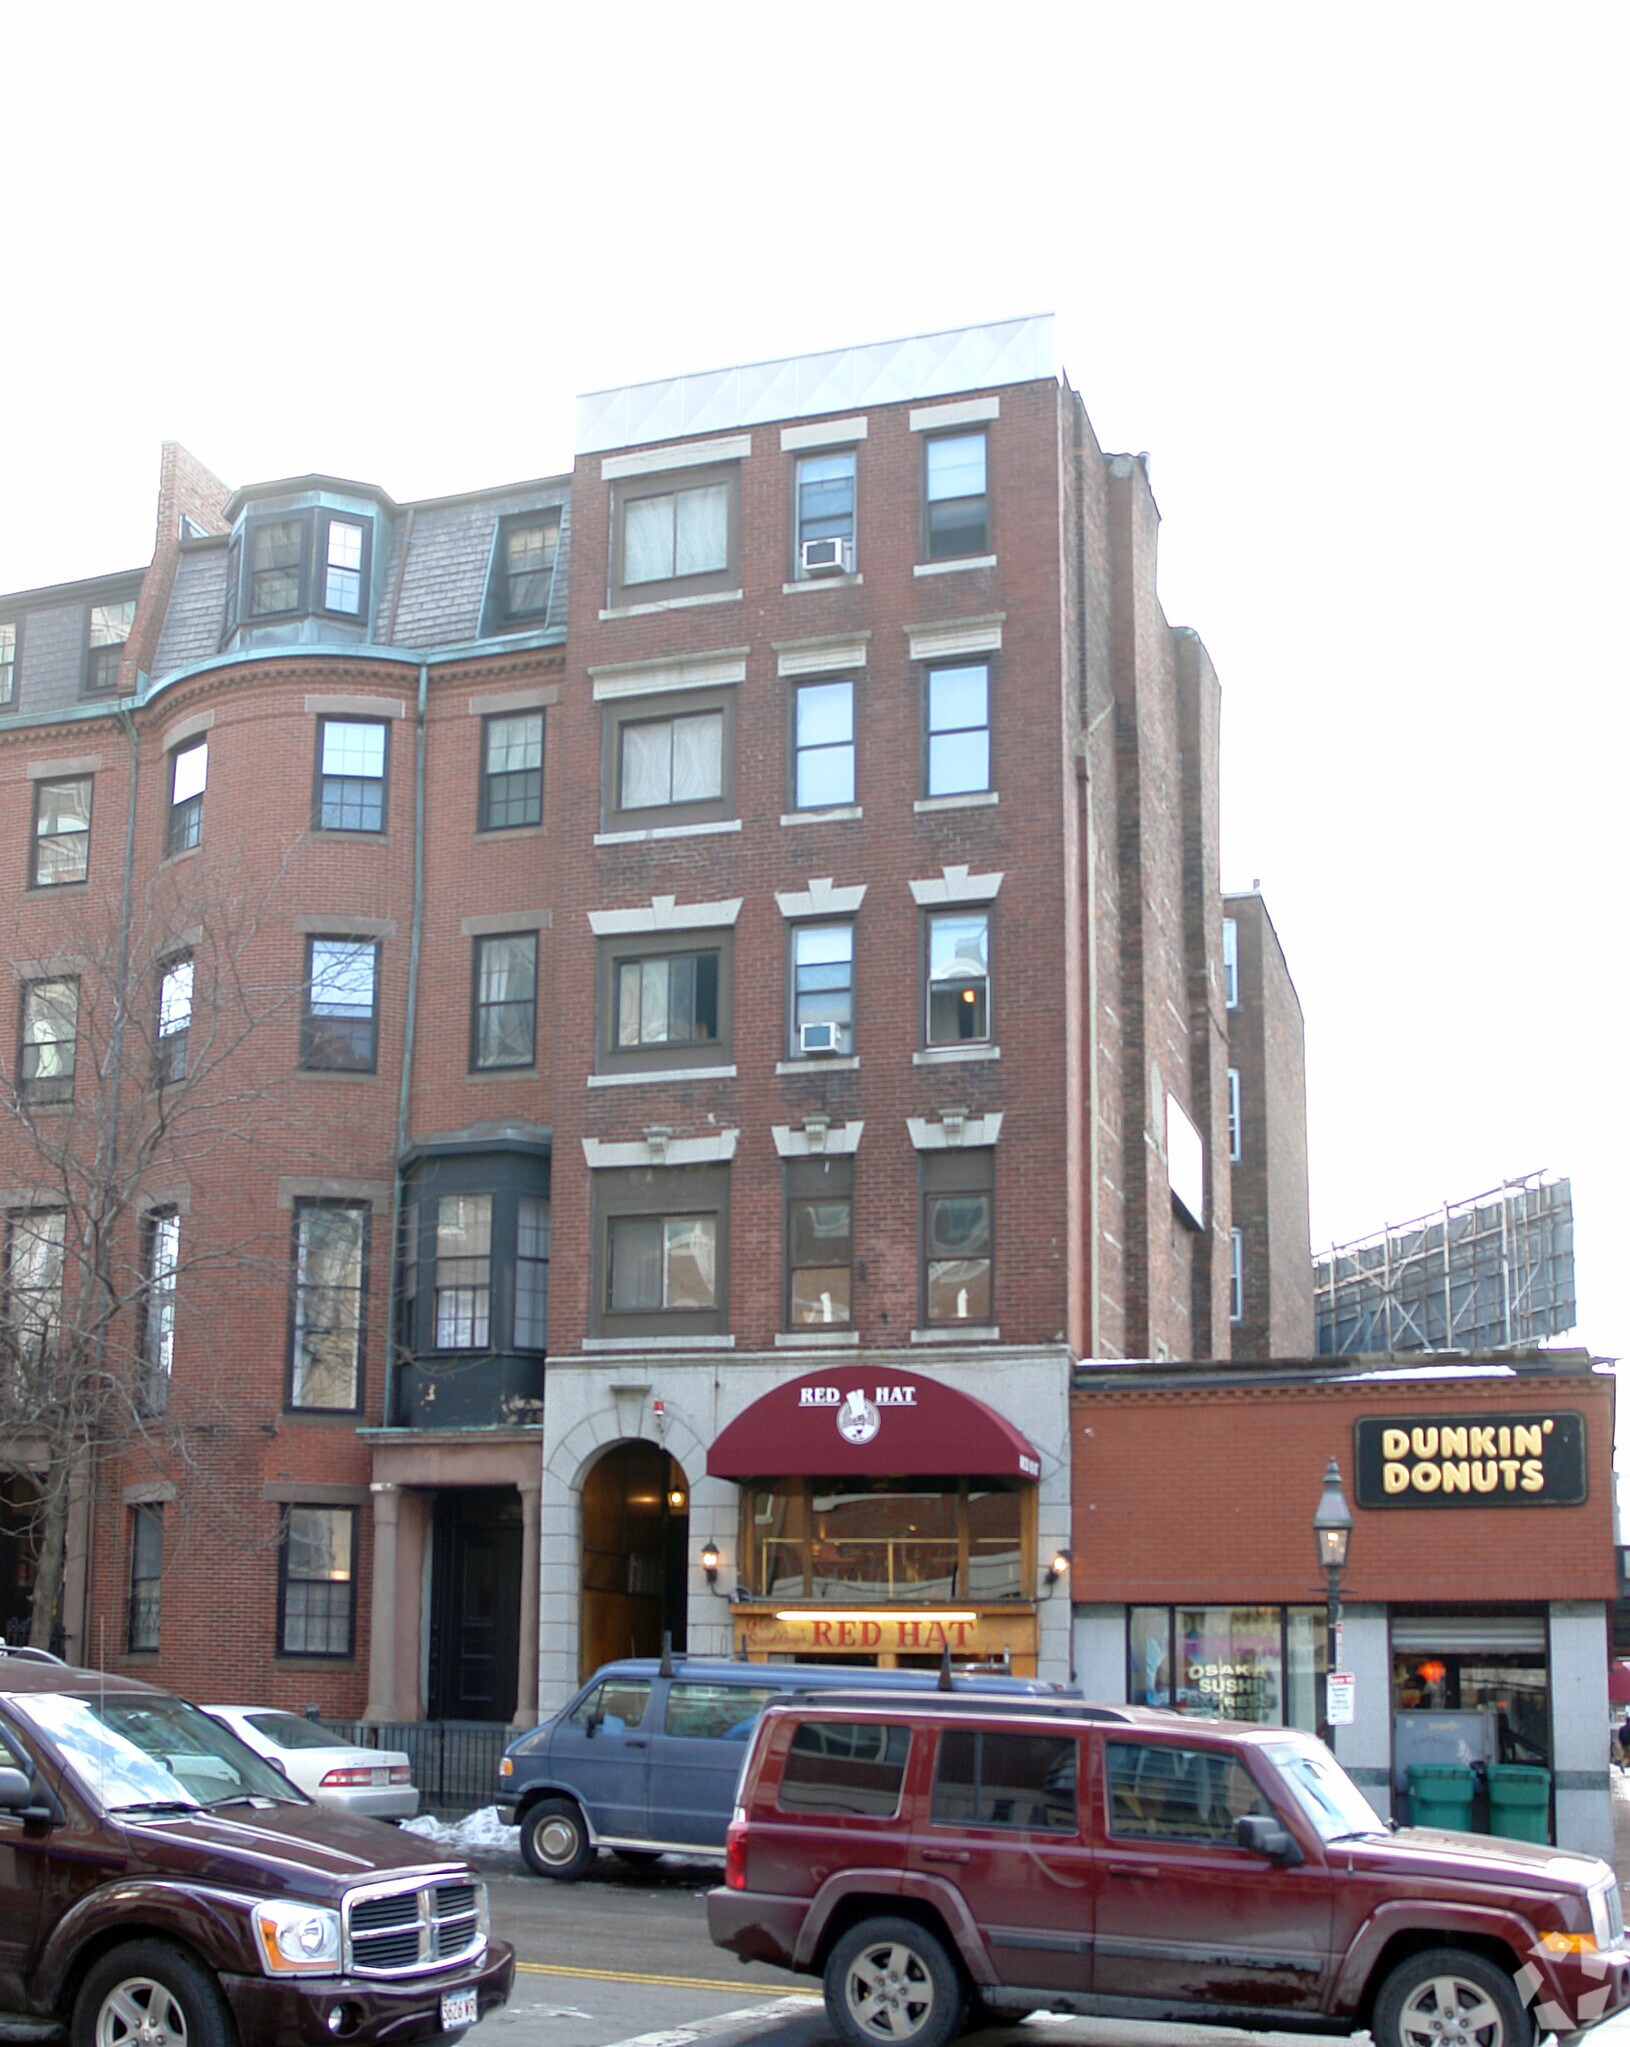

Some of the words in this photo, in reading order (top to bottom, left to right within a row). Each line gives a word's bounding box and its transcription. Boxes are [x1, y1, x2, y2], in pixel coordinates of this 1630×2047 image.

[800, 1387, 841, 1402] RED
[875, 1386, 916, 1402] HAT
[1382, 1419, 1554, 1461] DUNKIN'
[1382, 1459, 1544, 1494] DONUTS
[811, 1620, 882, 1648] RED
[896, 1621, 975, 1649] HAT
[1187, 1664, 1267, 1680] OSAKA
[1199, 1678, 1260, 1694] SUSHI
